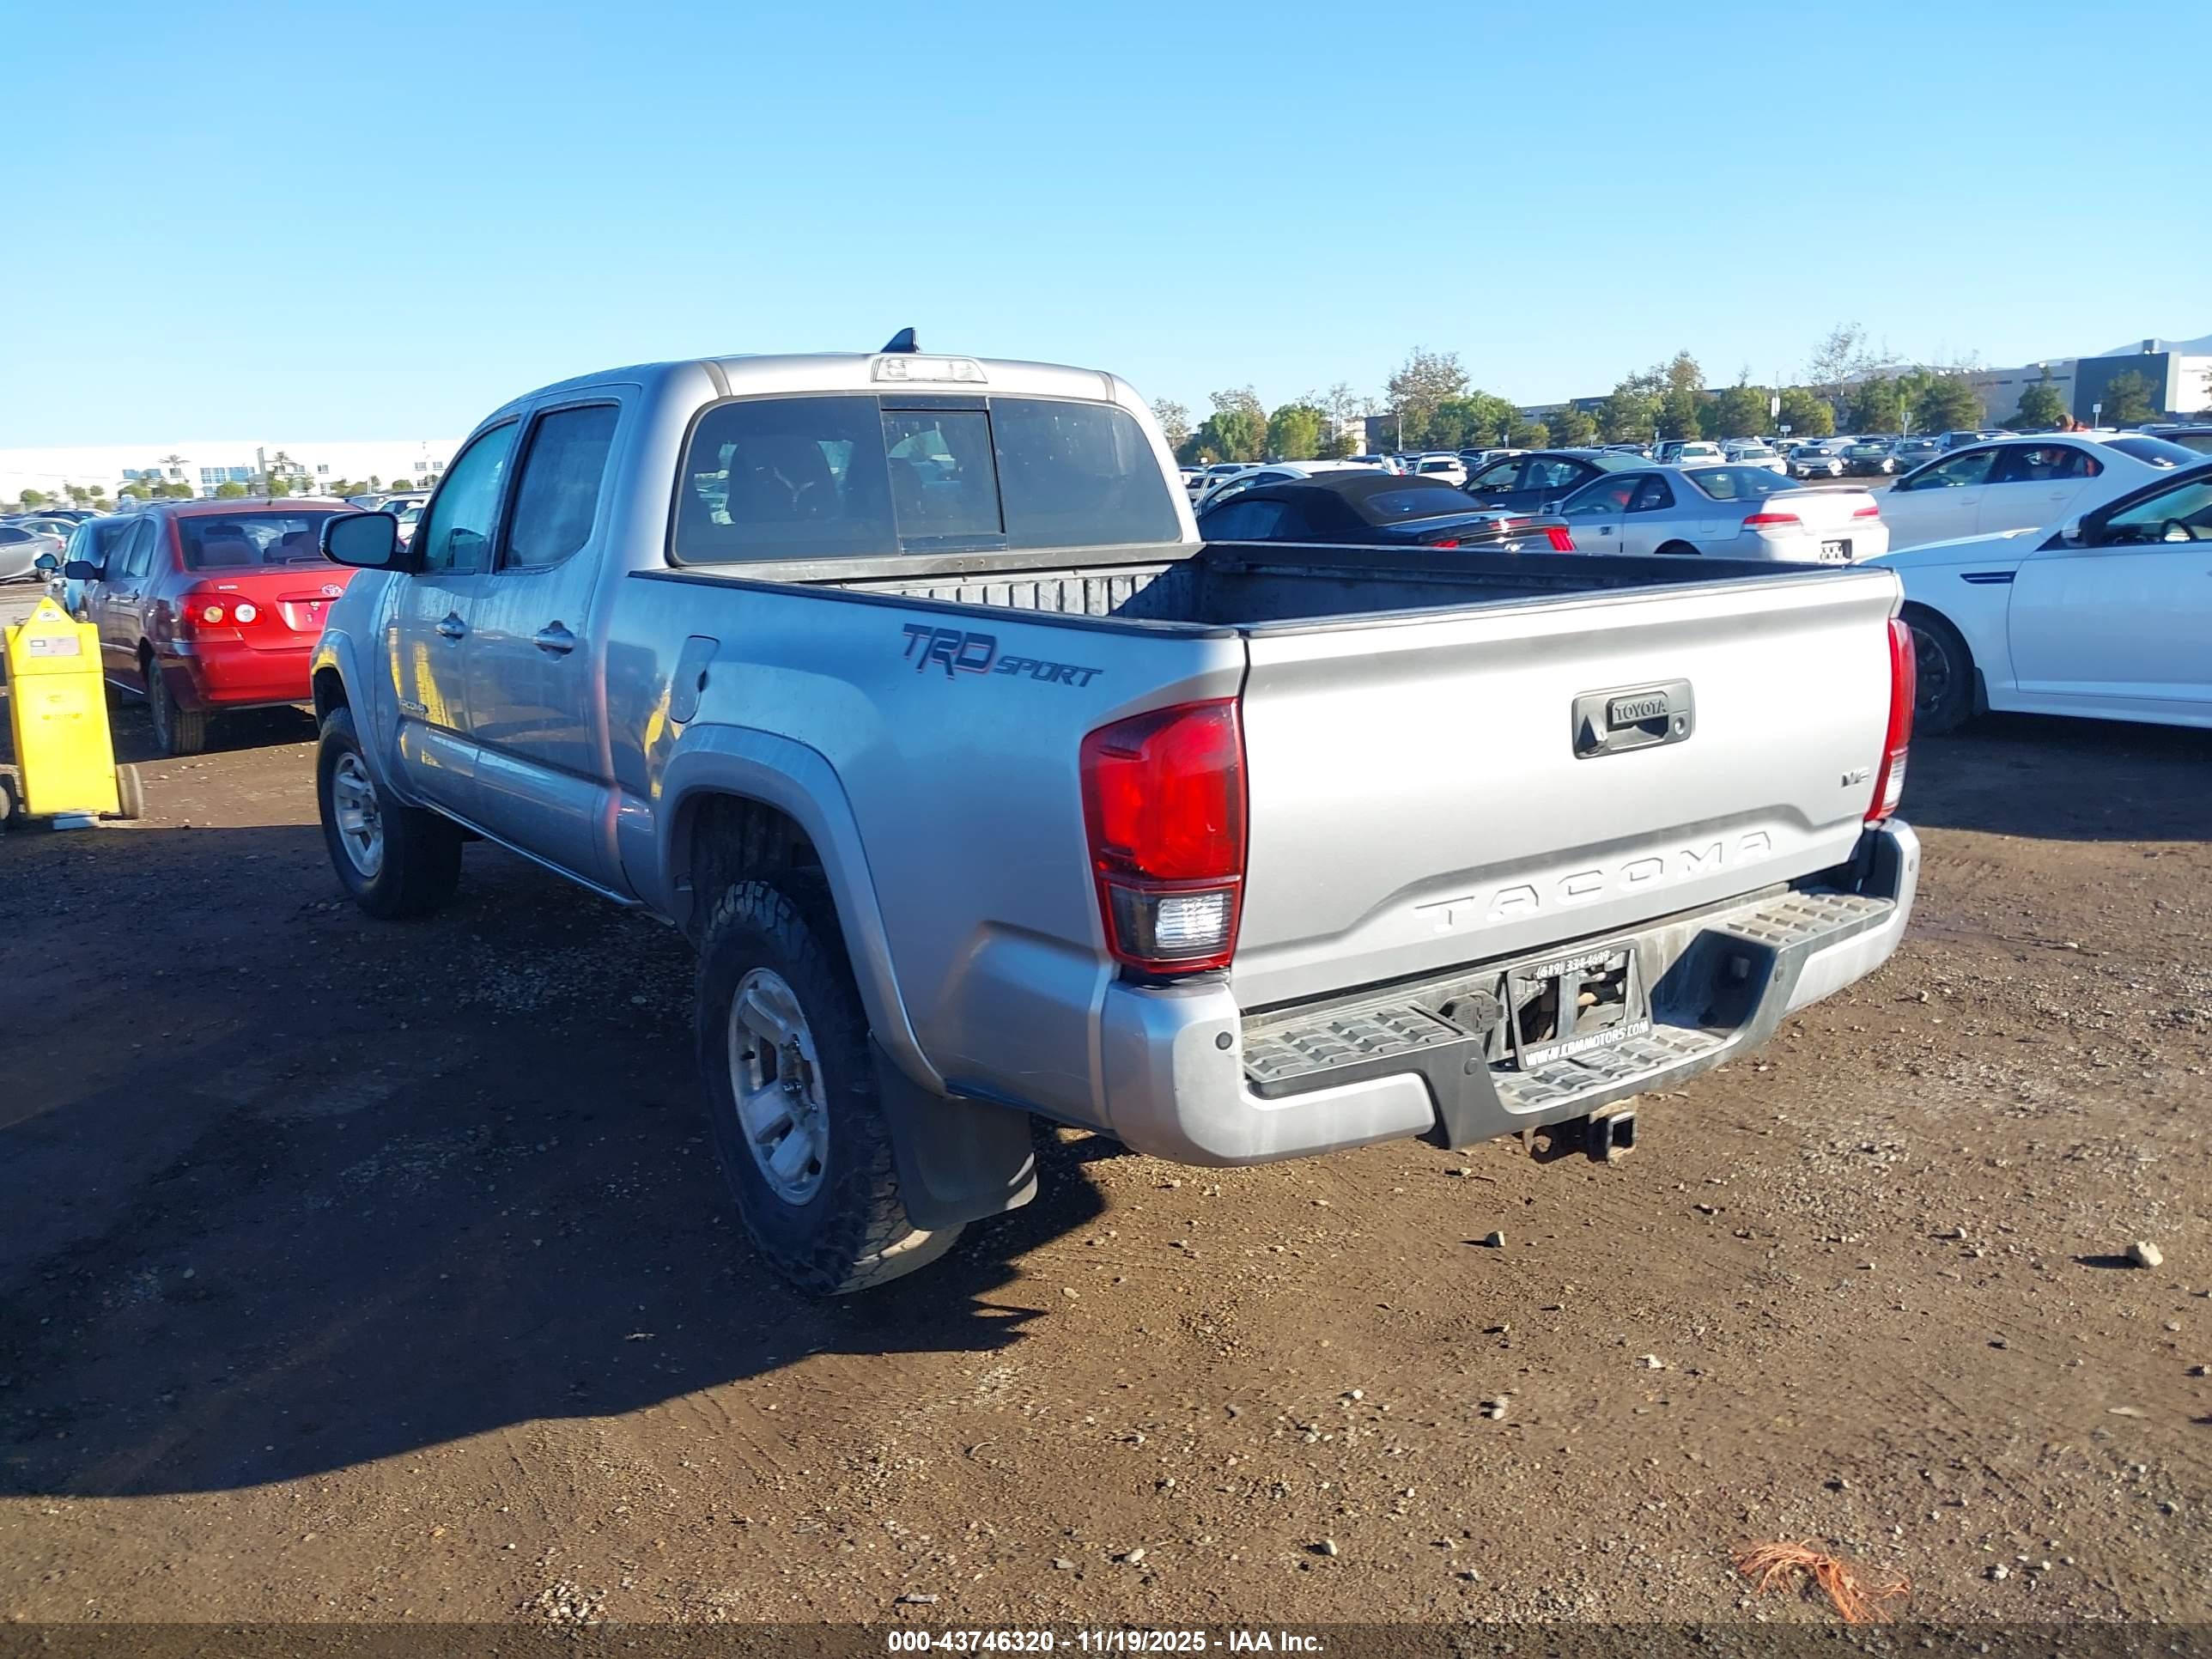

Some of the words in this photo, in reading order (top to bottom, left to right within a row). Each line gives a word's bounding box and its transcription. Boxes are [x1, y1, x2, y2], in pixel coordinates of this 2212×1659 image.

[902, 623, 997, 680] TRD
[994, 655, 1104, 688] SPORT
[1614, 700, 1668, 720] TOYOTA
[1413, 830, 1772, 933] TACOMA
